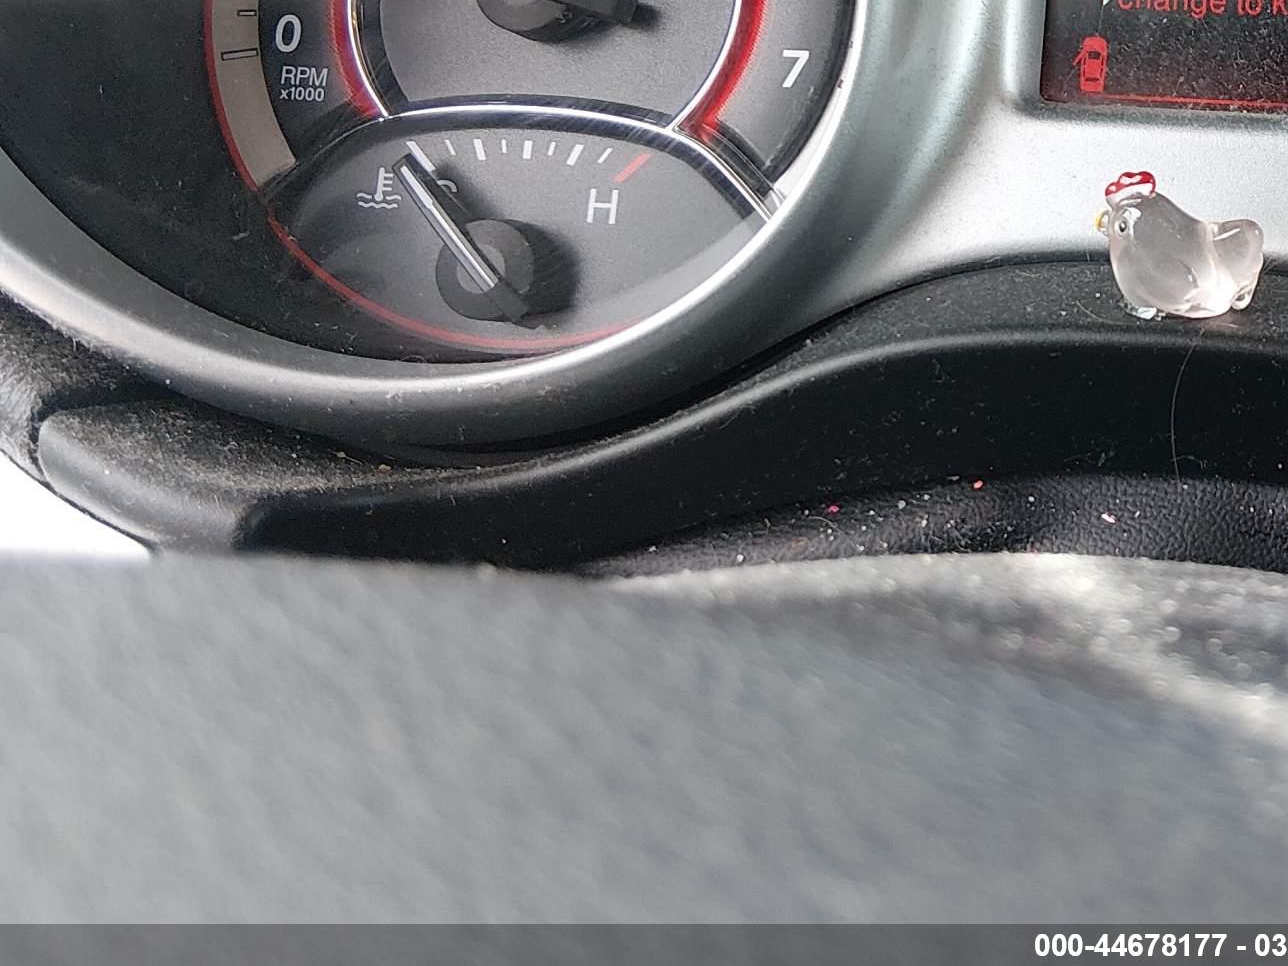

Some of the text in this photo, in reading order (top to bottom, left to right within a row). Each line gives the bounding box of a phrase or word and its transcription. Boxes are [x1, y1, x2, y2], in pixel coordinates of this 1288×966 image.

[275, 15, 302, 52] 0
[280, 65, 327, 86] RPM
[783, 49, 809, 88] 7
[280, 86, 324, 101] x1000
[588, 189, 619, 224] H
